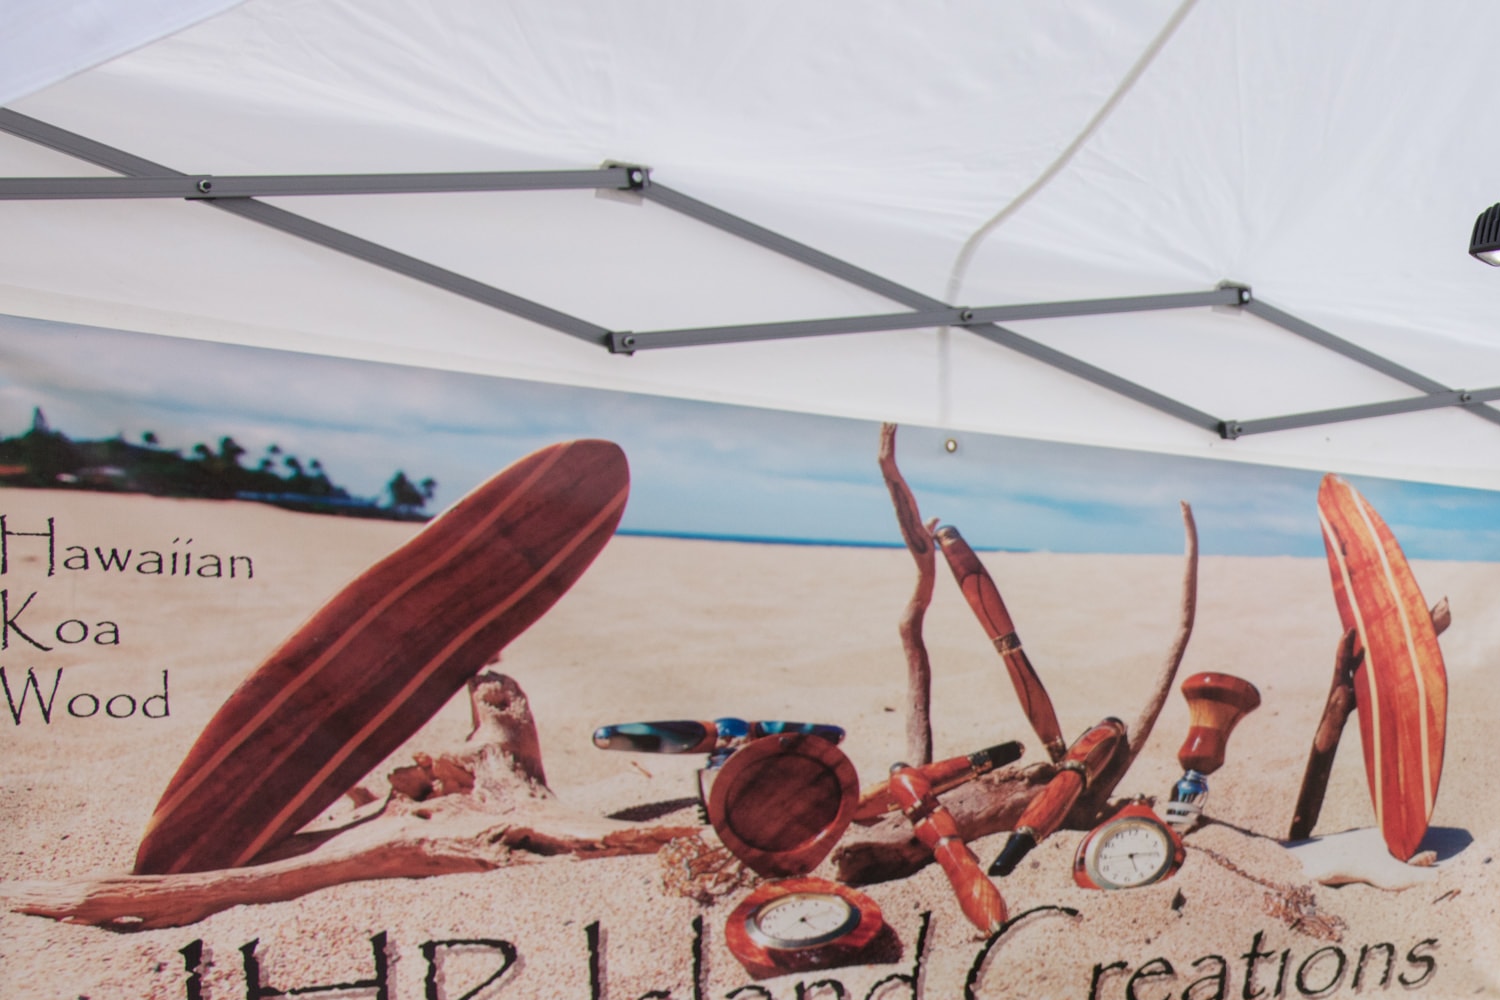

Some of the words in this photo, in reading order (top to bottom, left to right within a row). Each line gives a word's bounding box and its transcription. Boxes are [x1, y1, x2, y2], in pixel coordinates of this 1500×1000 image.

[0, 514, 255, 580] Hawaiian
[0, 589, 120, 652] Koa
[0, 666, 170, 726] Wood
